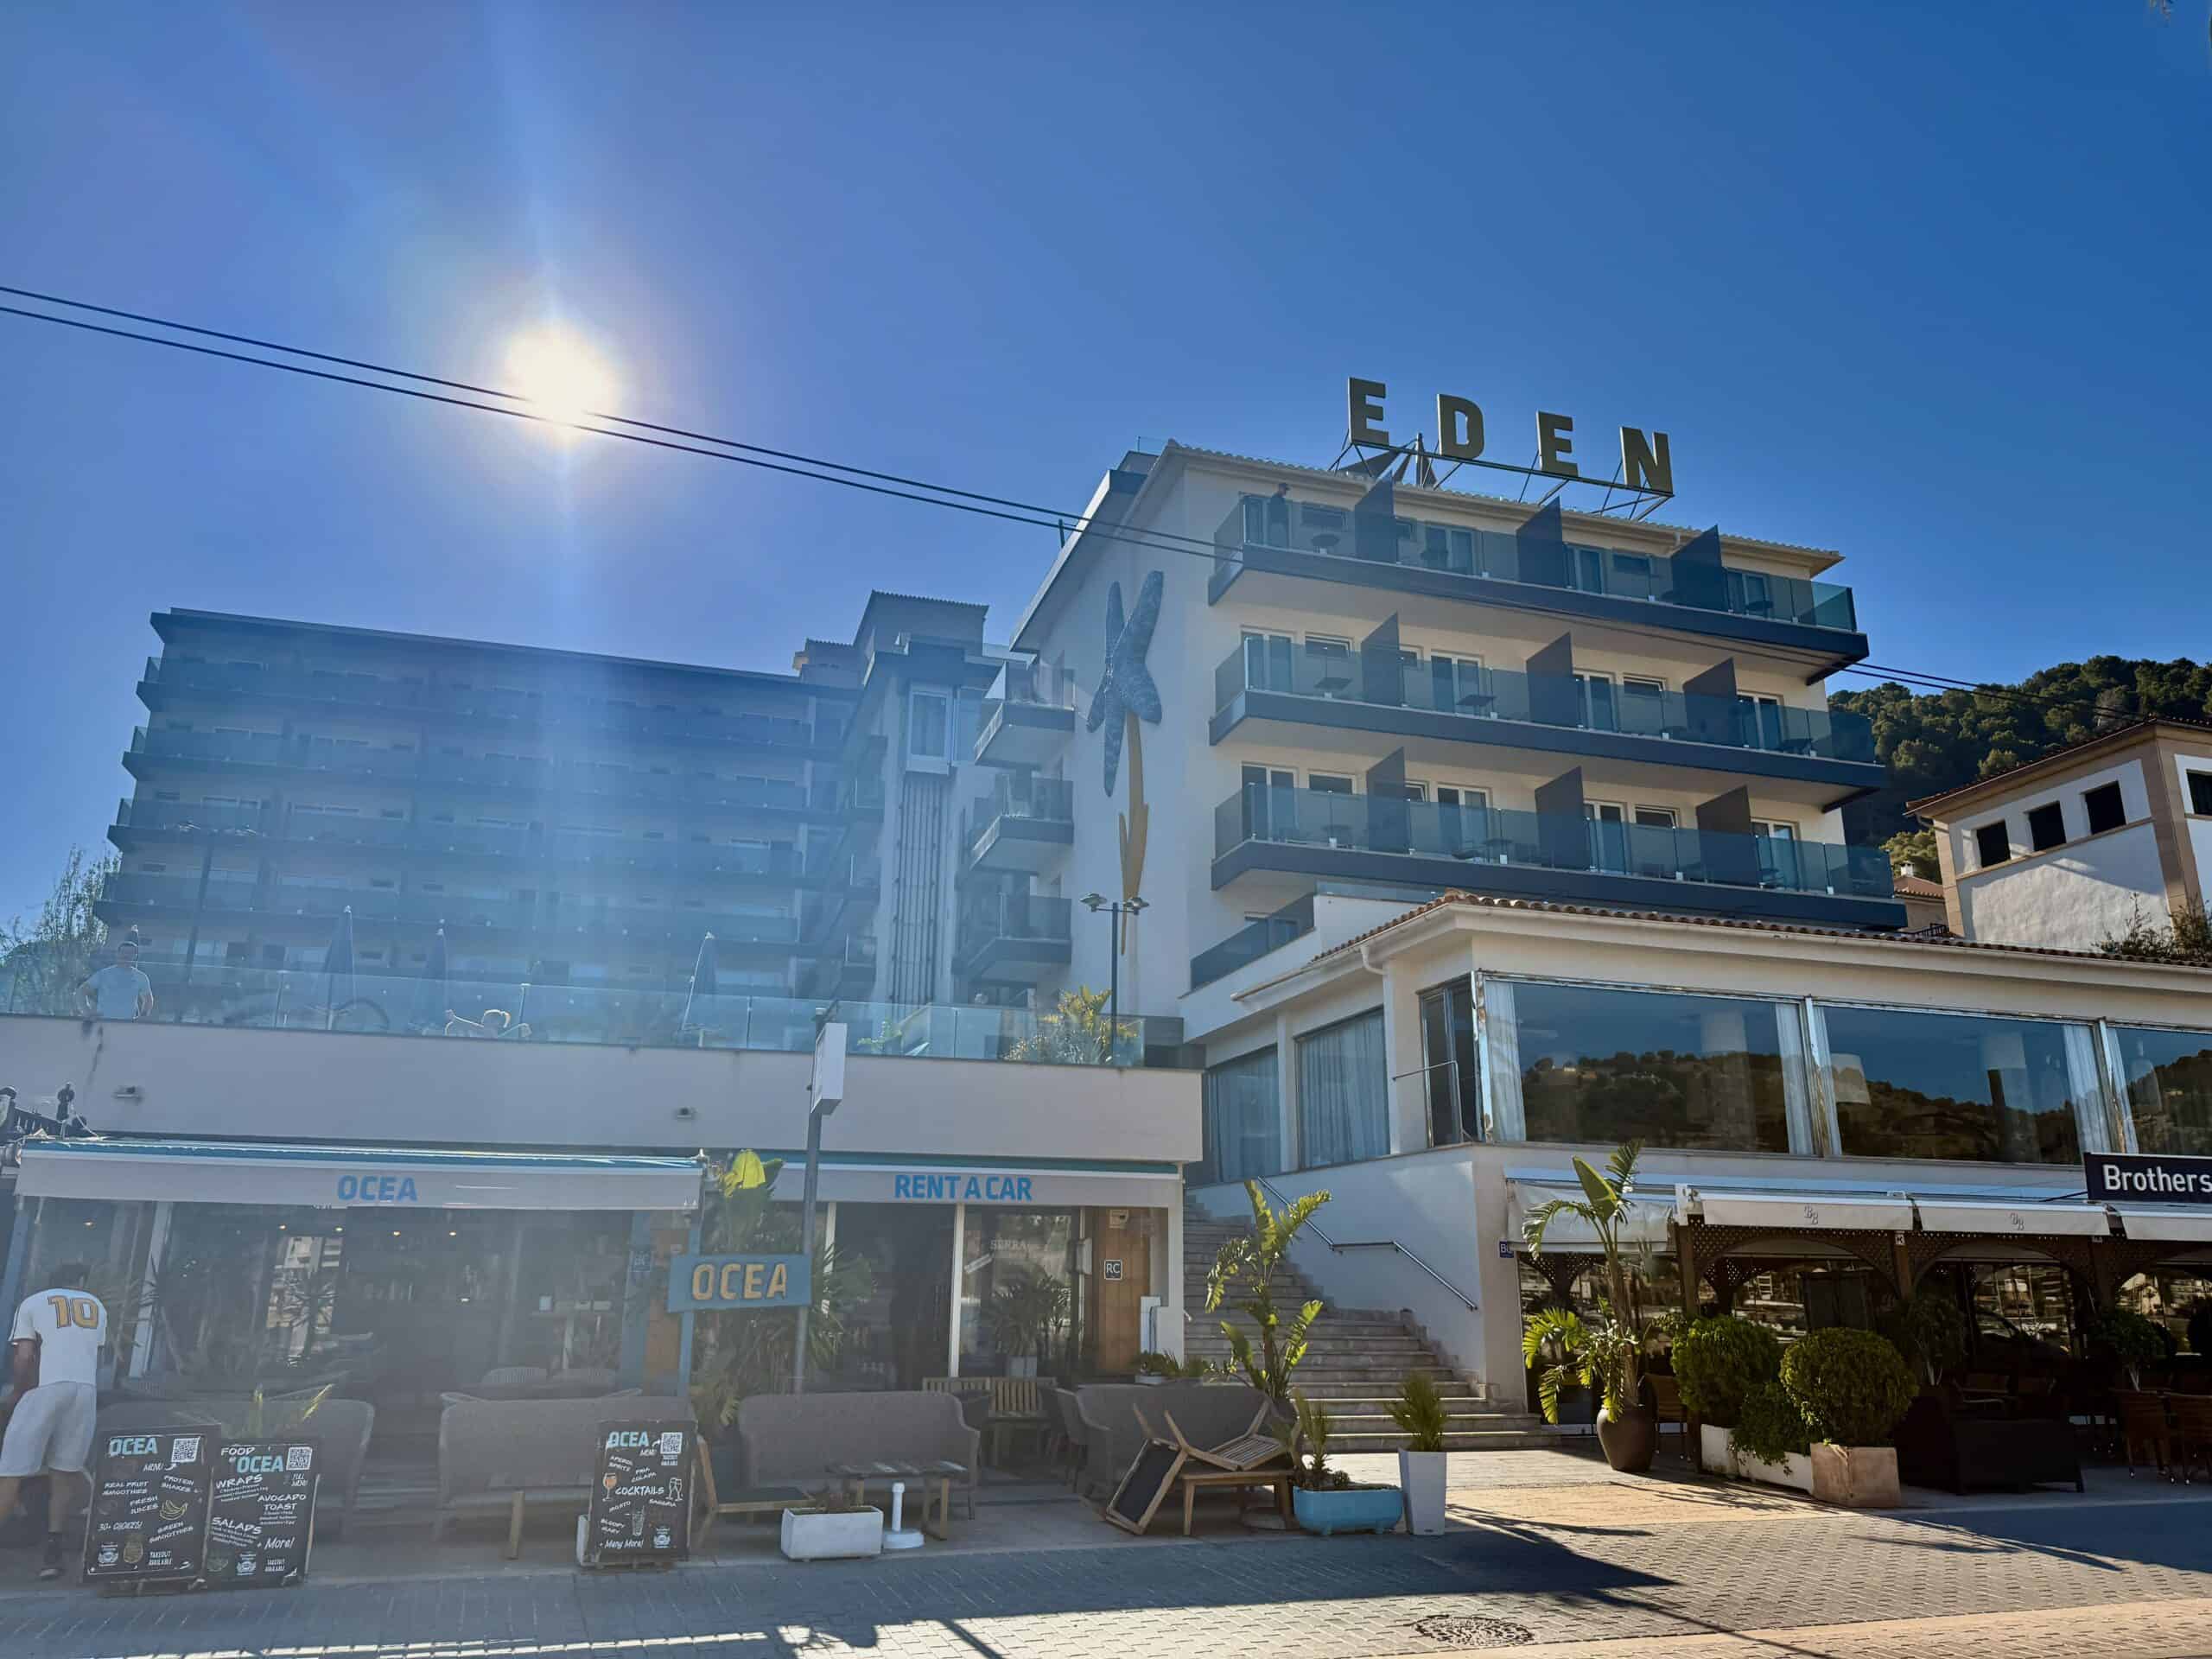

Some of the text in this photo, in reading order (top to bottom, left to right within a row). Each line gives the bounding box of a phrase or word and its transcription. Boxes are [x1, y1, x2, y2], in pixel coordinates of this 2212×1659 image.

[1348, 377, 1673, 493] EDEN
[2103, 1164, 2212, 1193] Brothers
[337, 1174, 418, 1202] OCEA
[894, 1174, 1033, 1201] RENT A CAR
[1106, 1263, 1121, 1274] RC
[691, 1263, 788, 1300] OCEA
[48, 1295, 99, 1329] 10
[607, 1431, 649, 1447] OCEA
[108, 1437, 158, 1458] OCEA
[221, 1446, 255, 1456] FOOD
[236, 1456, 283, 1473] OCEA
[163, 1475, 194, 1485] PROTEIN
[215, 1474, 263, 1489] WRAPS
[615, 1485, 664, 1496] COCKTAILS
[130, 1495, 158, 1506] FRESH
[157, 1522, 184, 1534] GREEN
[212, 1517, 262, 1535] SALADS
[264, 1536, 296, 1550] More!
